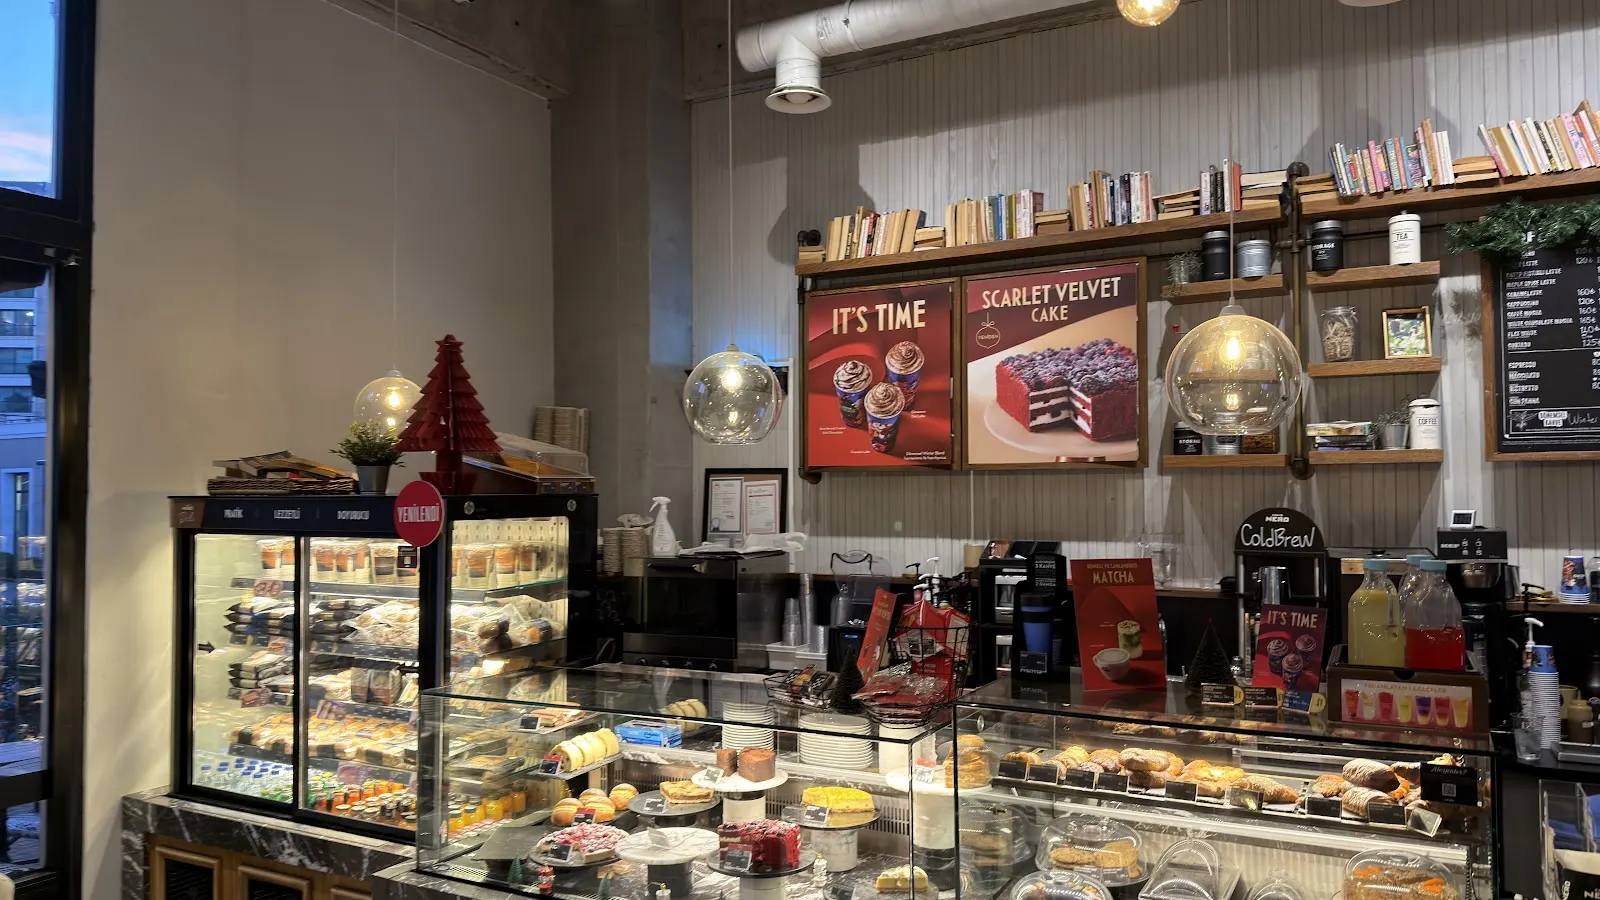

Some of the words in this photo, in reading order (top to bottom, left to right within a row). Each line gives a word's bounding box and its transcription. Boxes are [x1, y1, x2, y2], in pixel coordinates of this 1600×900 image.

[1396, 232, 1409, 241] TEA
[982, 284, 1051, 309] SCARLET
[1055, 276, 1122, 302] VELVET
[832, 305, 869, 335] IT'S
[875, 299, 927, 332] TIME
[1031, 304, 1069, 323] CAKE
[1508, 361, 1536, 370] ESPRESSO
[397, 502, 441, 523] YENİLENDİ
[1093, 570, 1135, 585] MATCHA
[1267, 609, 1288, 626] IT'S
[1291, 612, 1319, 629] TIME
